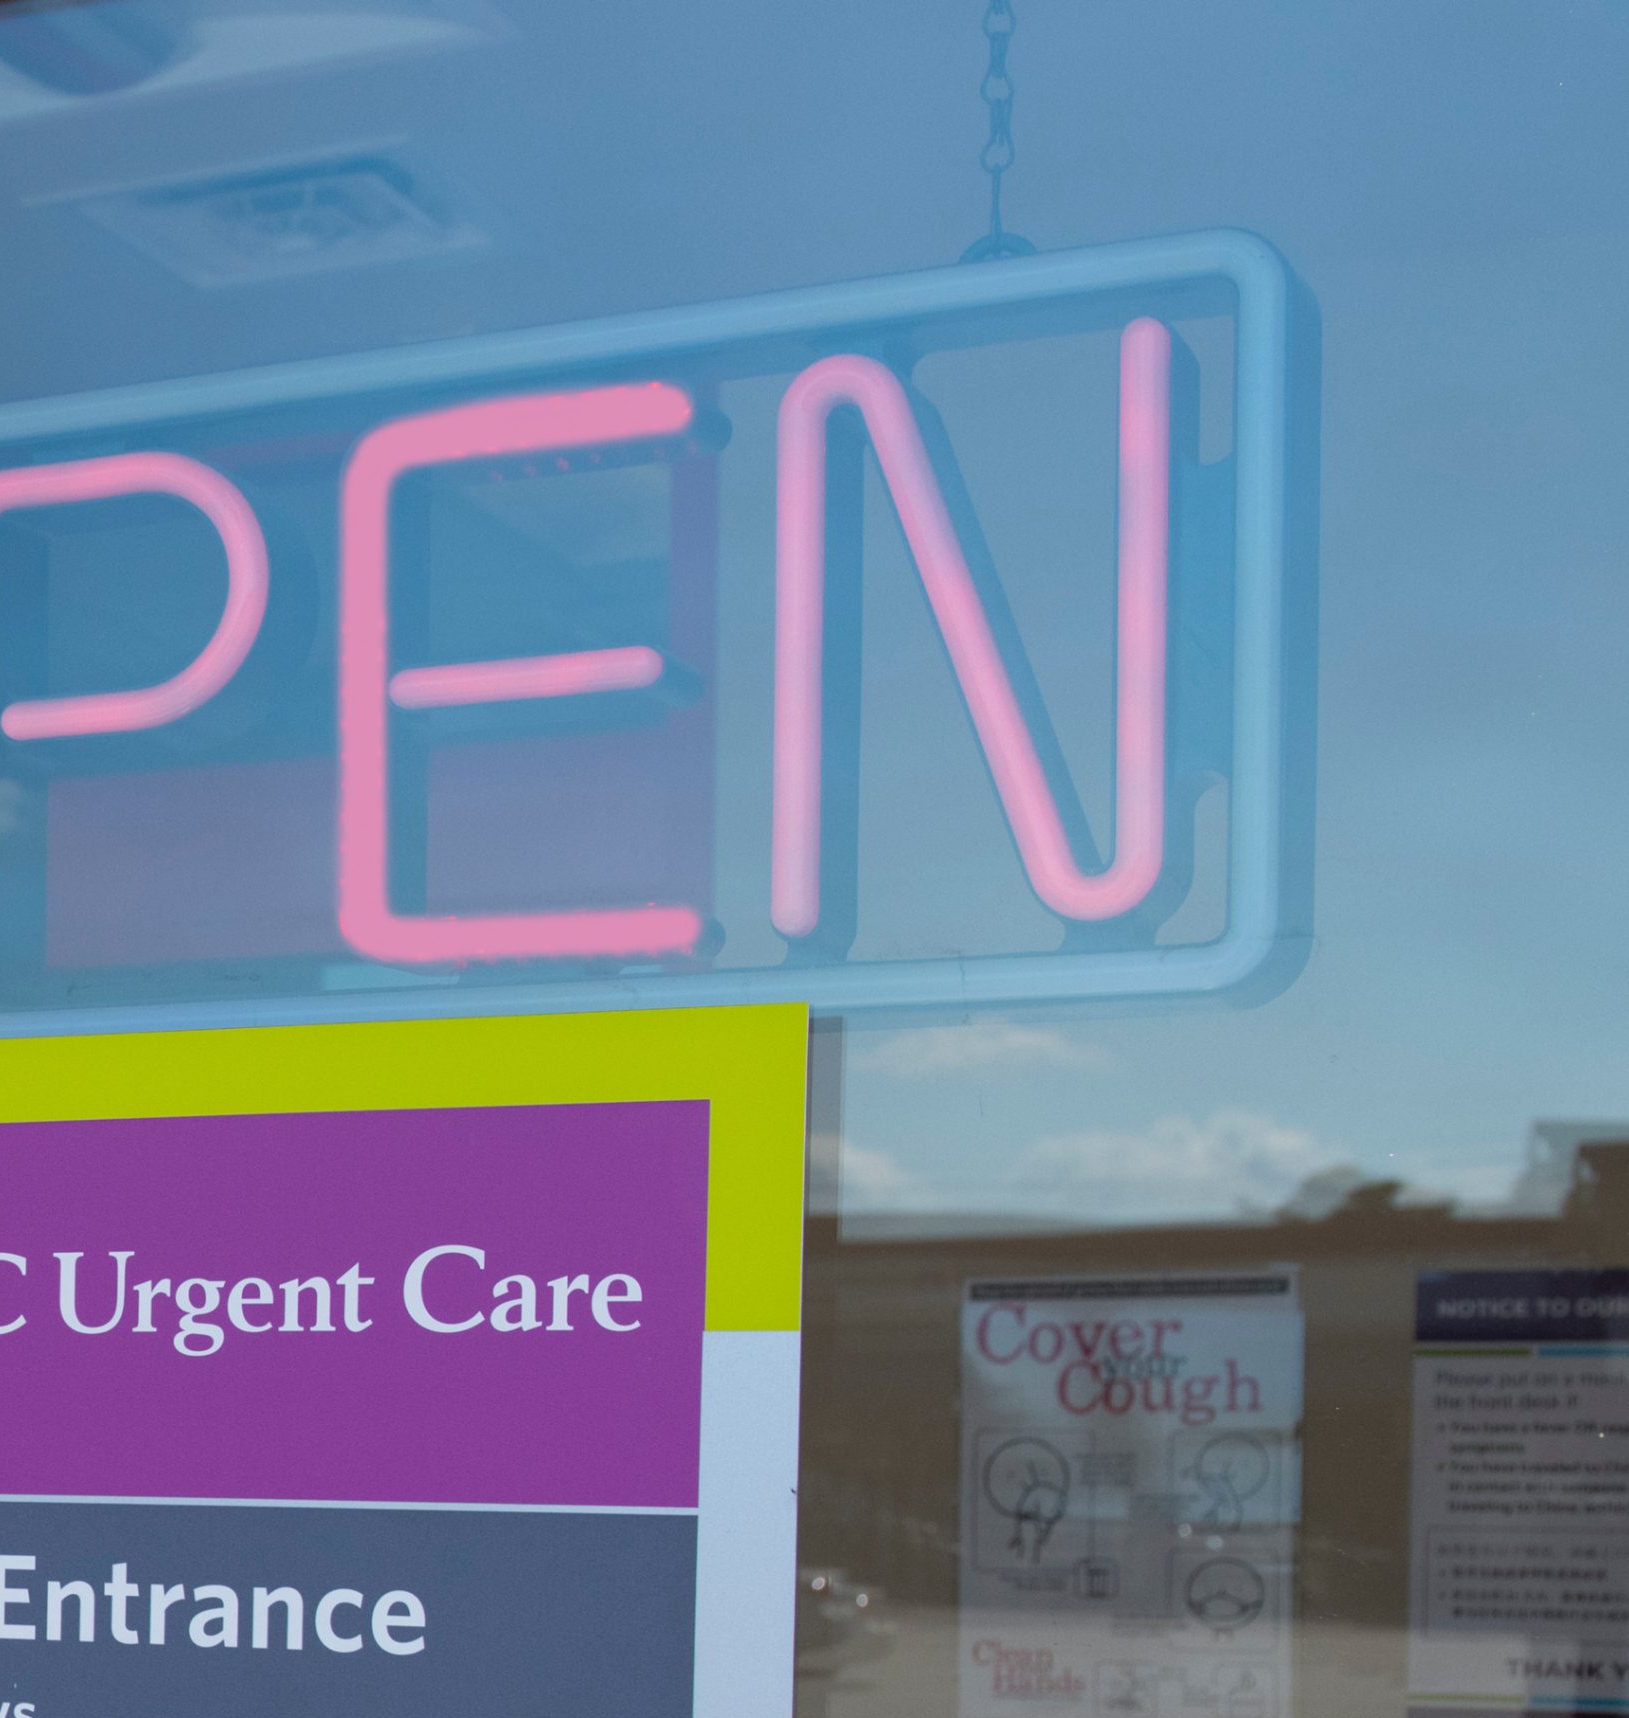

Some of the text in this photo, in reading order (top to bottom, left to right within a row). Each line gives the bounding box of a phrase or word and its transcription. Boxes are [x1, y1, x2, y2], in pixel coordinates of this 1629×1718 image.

[53, 1251, 375, 1356] Urgent
[404, 1245, 642, 1333] Care
[975, 1300, 1183, 1366] Cover
[1057, 1358, 1263, 1427] Cough
